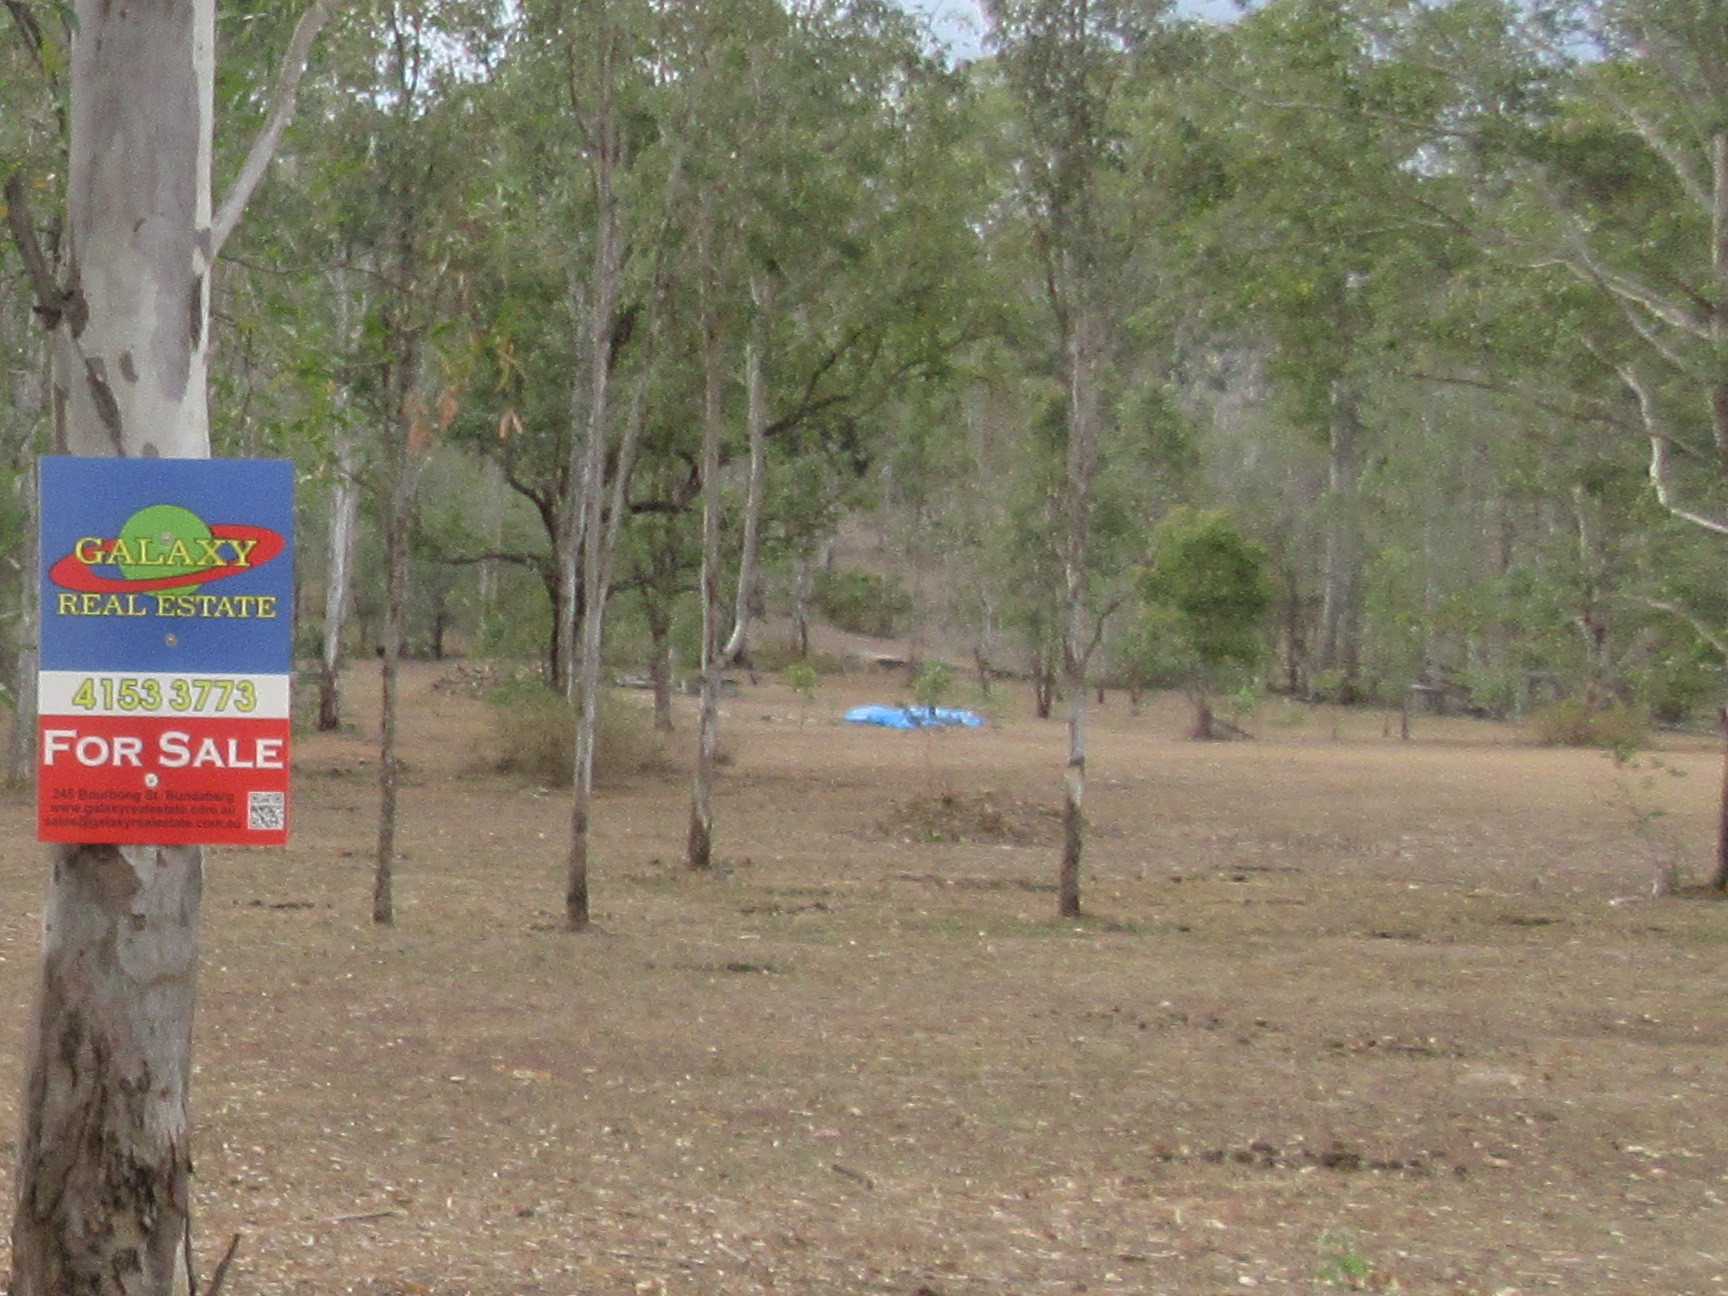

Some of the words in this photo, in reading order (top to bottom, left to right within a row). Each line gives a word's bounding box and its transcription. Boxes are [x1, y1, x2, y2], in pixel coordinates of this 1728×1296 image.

[74, 537, 257, 567] GALAXY
[57, 593, 146, 616] REAL
[155, 594, 276, 618] ESTATE
[72, 678, 163, 711] 4153
[168, 679, 257, 713] 3773
